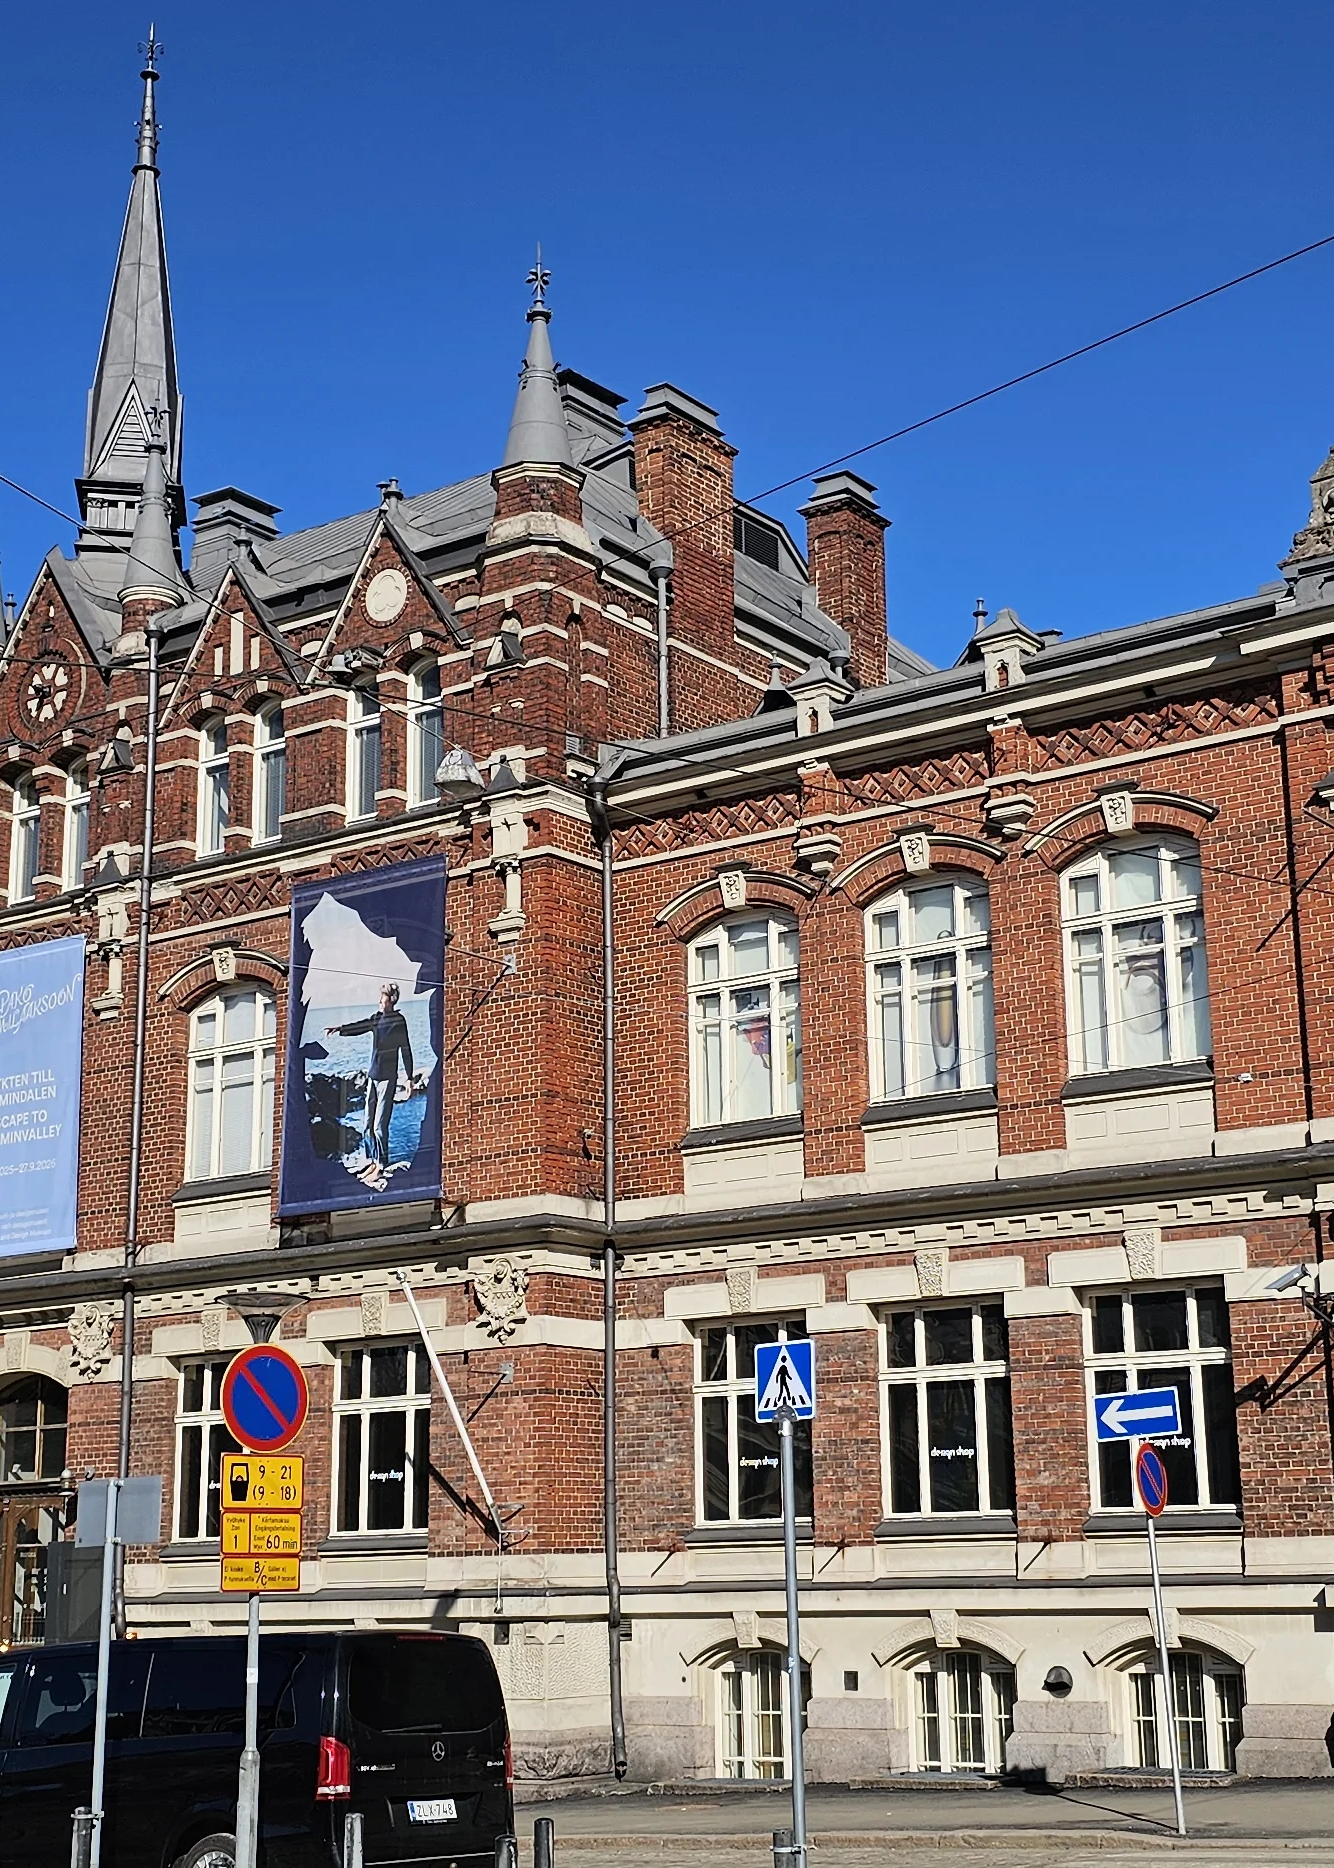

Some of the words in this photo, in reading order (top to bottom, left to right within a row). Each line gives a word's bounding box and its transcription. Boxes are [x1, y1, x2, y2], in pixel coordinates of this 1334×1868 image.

[31, 1069, 55, 1085] TILL
[31, 1109, 48, 1123] TO
[1171, 1434, 1192, 1449] shop
[258, 1465, 266, 1480] 9
[280, 1465, 292, 1480] 21
[252, 1485, 265, 1501] (9
[280, 1485, 297, 1501] 18)
[233, 1534, 238, 1549] 1
[266, 1534, 281, 1549] 60
[282, 1538, 298, 1550] min
[416, 1803, 454, 1818] ZLX-748
